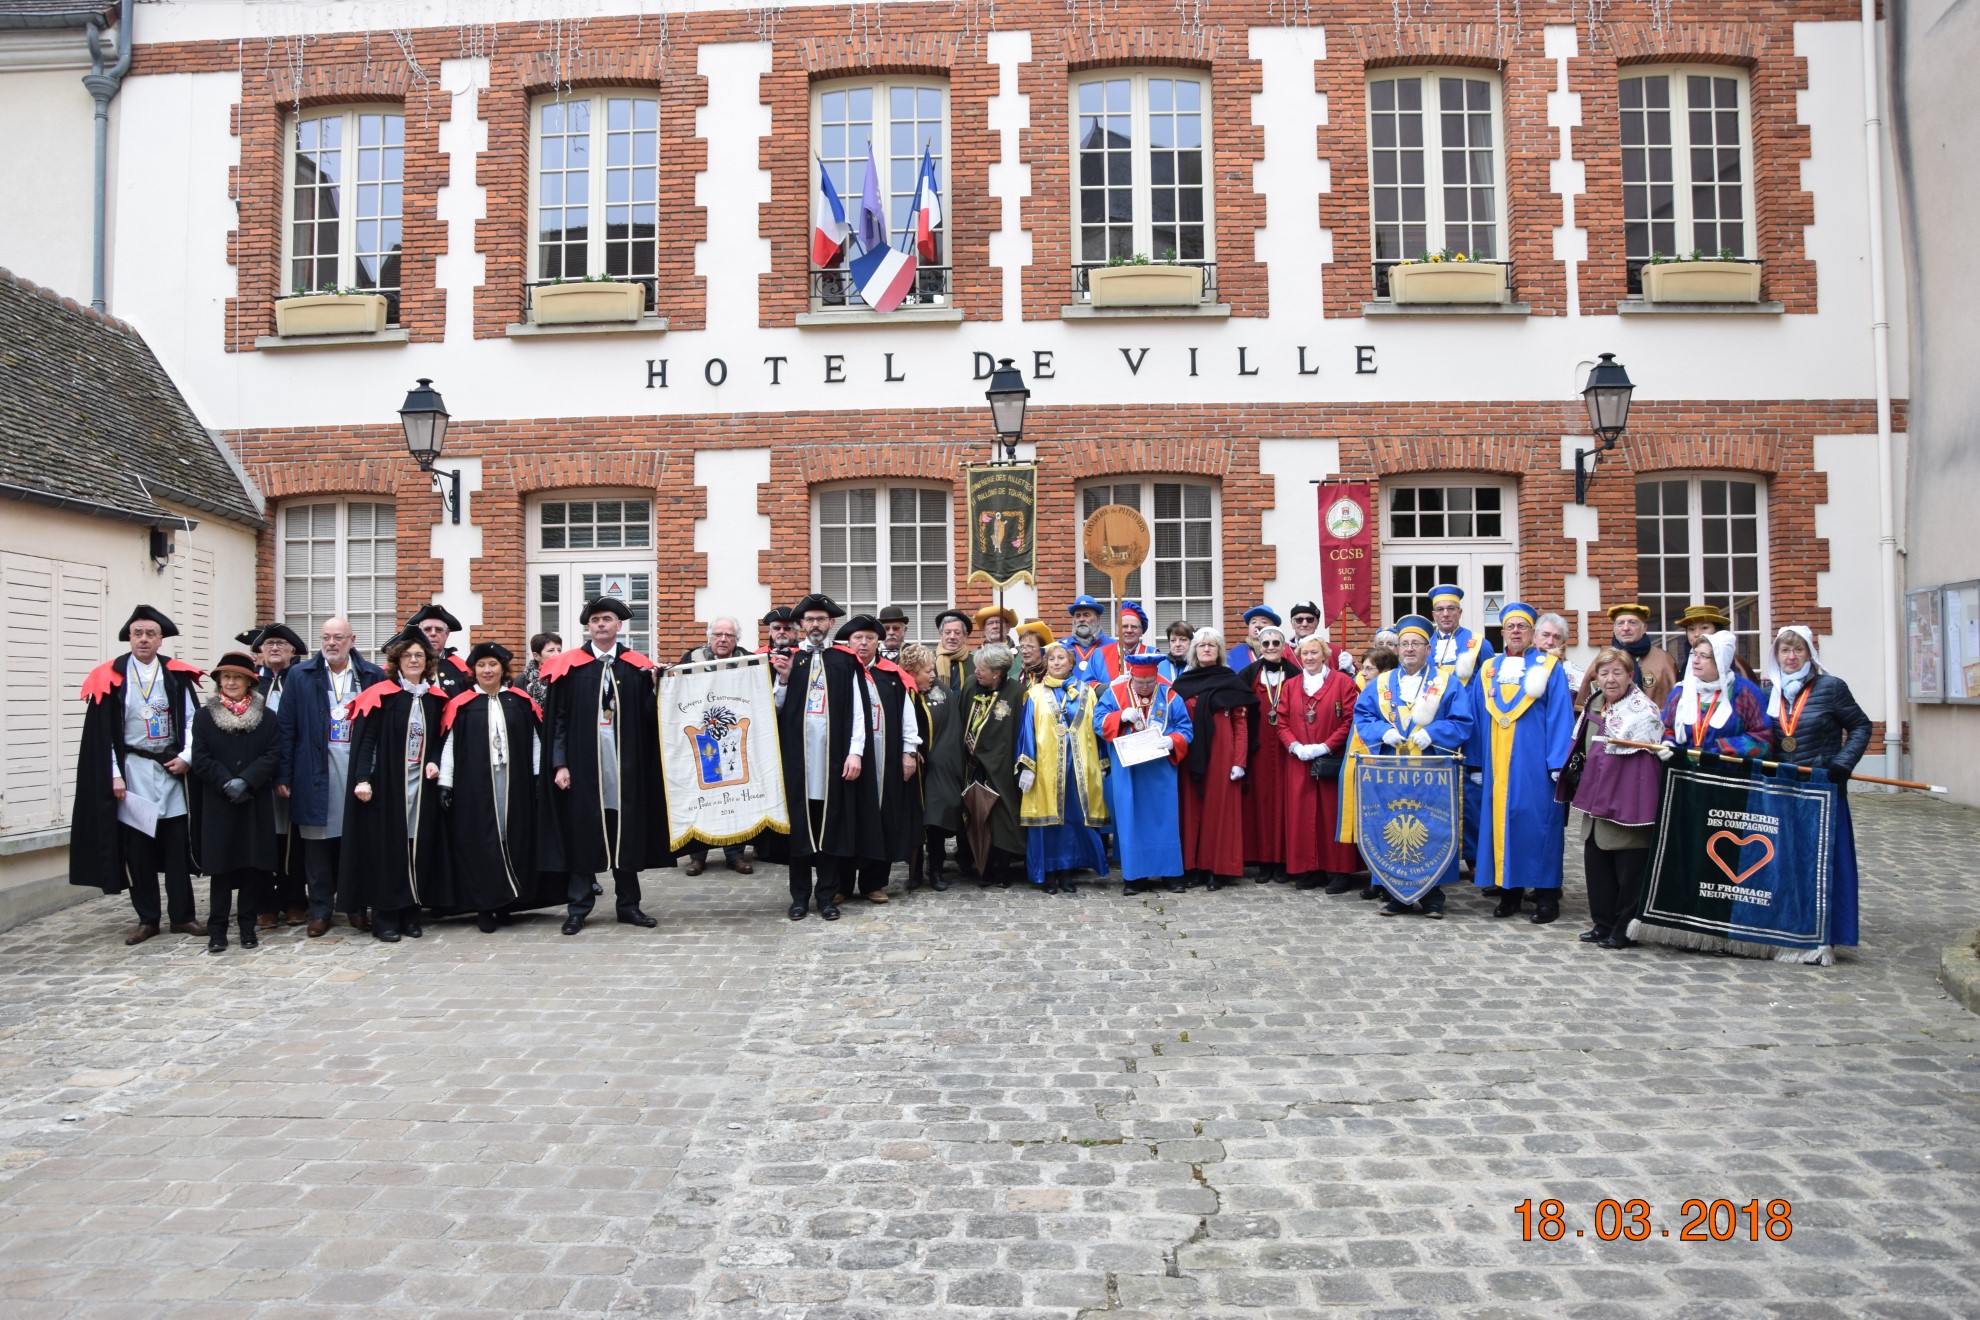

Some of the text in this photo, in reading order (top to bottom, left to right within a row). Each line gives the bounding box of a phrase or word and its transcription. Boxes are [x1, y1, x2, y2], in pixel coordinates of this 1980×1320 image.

[645, 346, 1379, 388] HOTEL DE VILLE
[995, 474, 1007, 482] DES
[998, 487, 1006, 495] DE
[1329, 548, 1364, 561] CCSB
[1338, 567, 1356, 575] SUCY
[1362, 769, 1447, 787] ALENÇON
[1708, 809, 1779, 825] CONFRERIE
[1707, 818, 1779, 834] DES COMPAGNONS
[1699, 882, 1772, 899] DU FROMAGE
[1699, 889, 1771, 906] NEUFCHATEL
